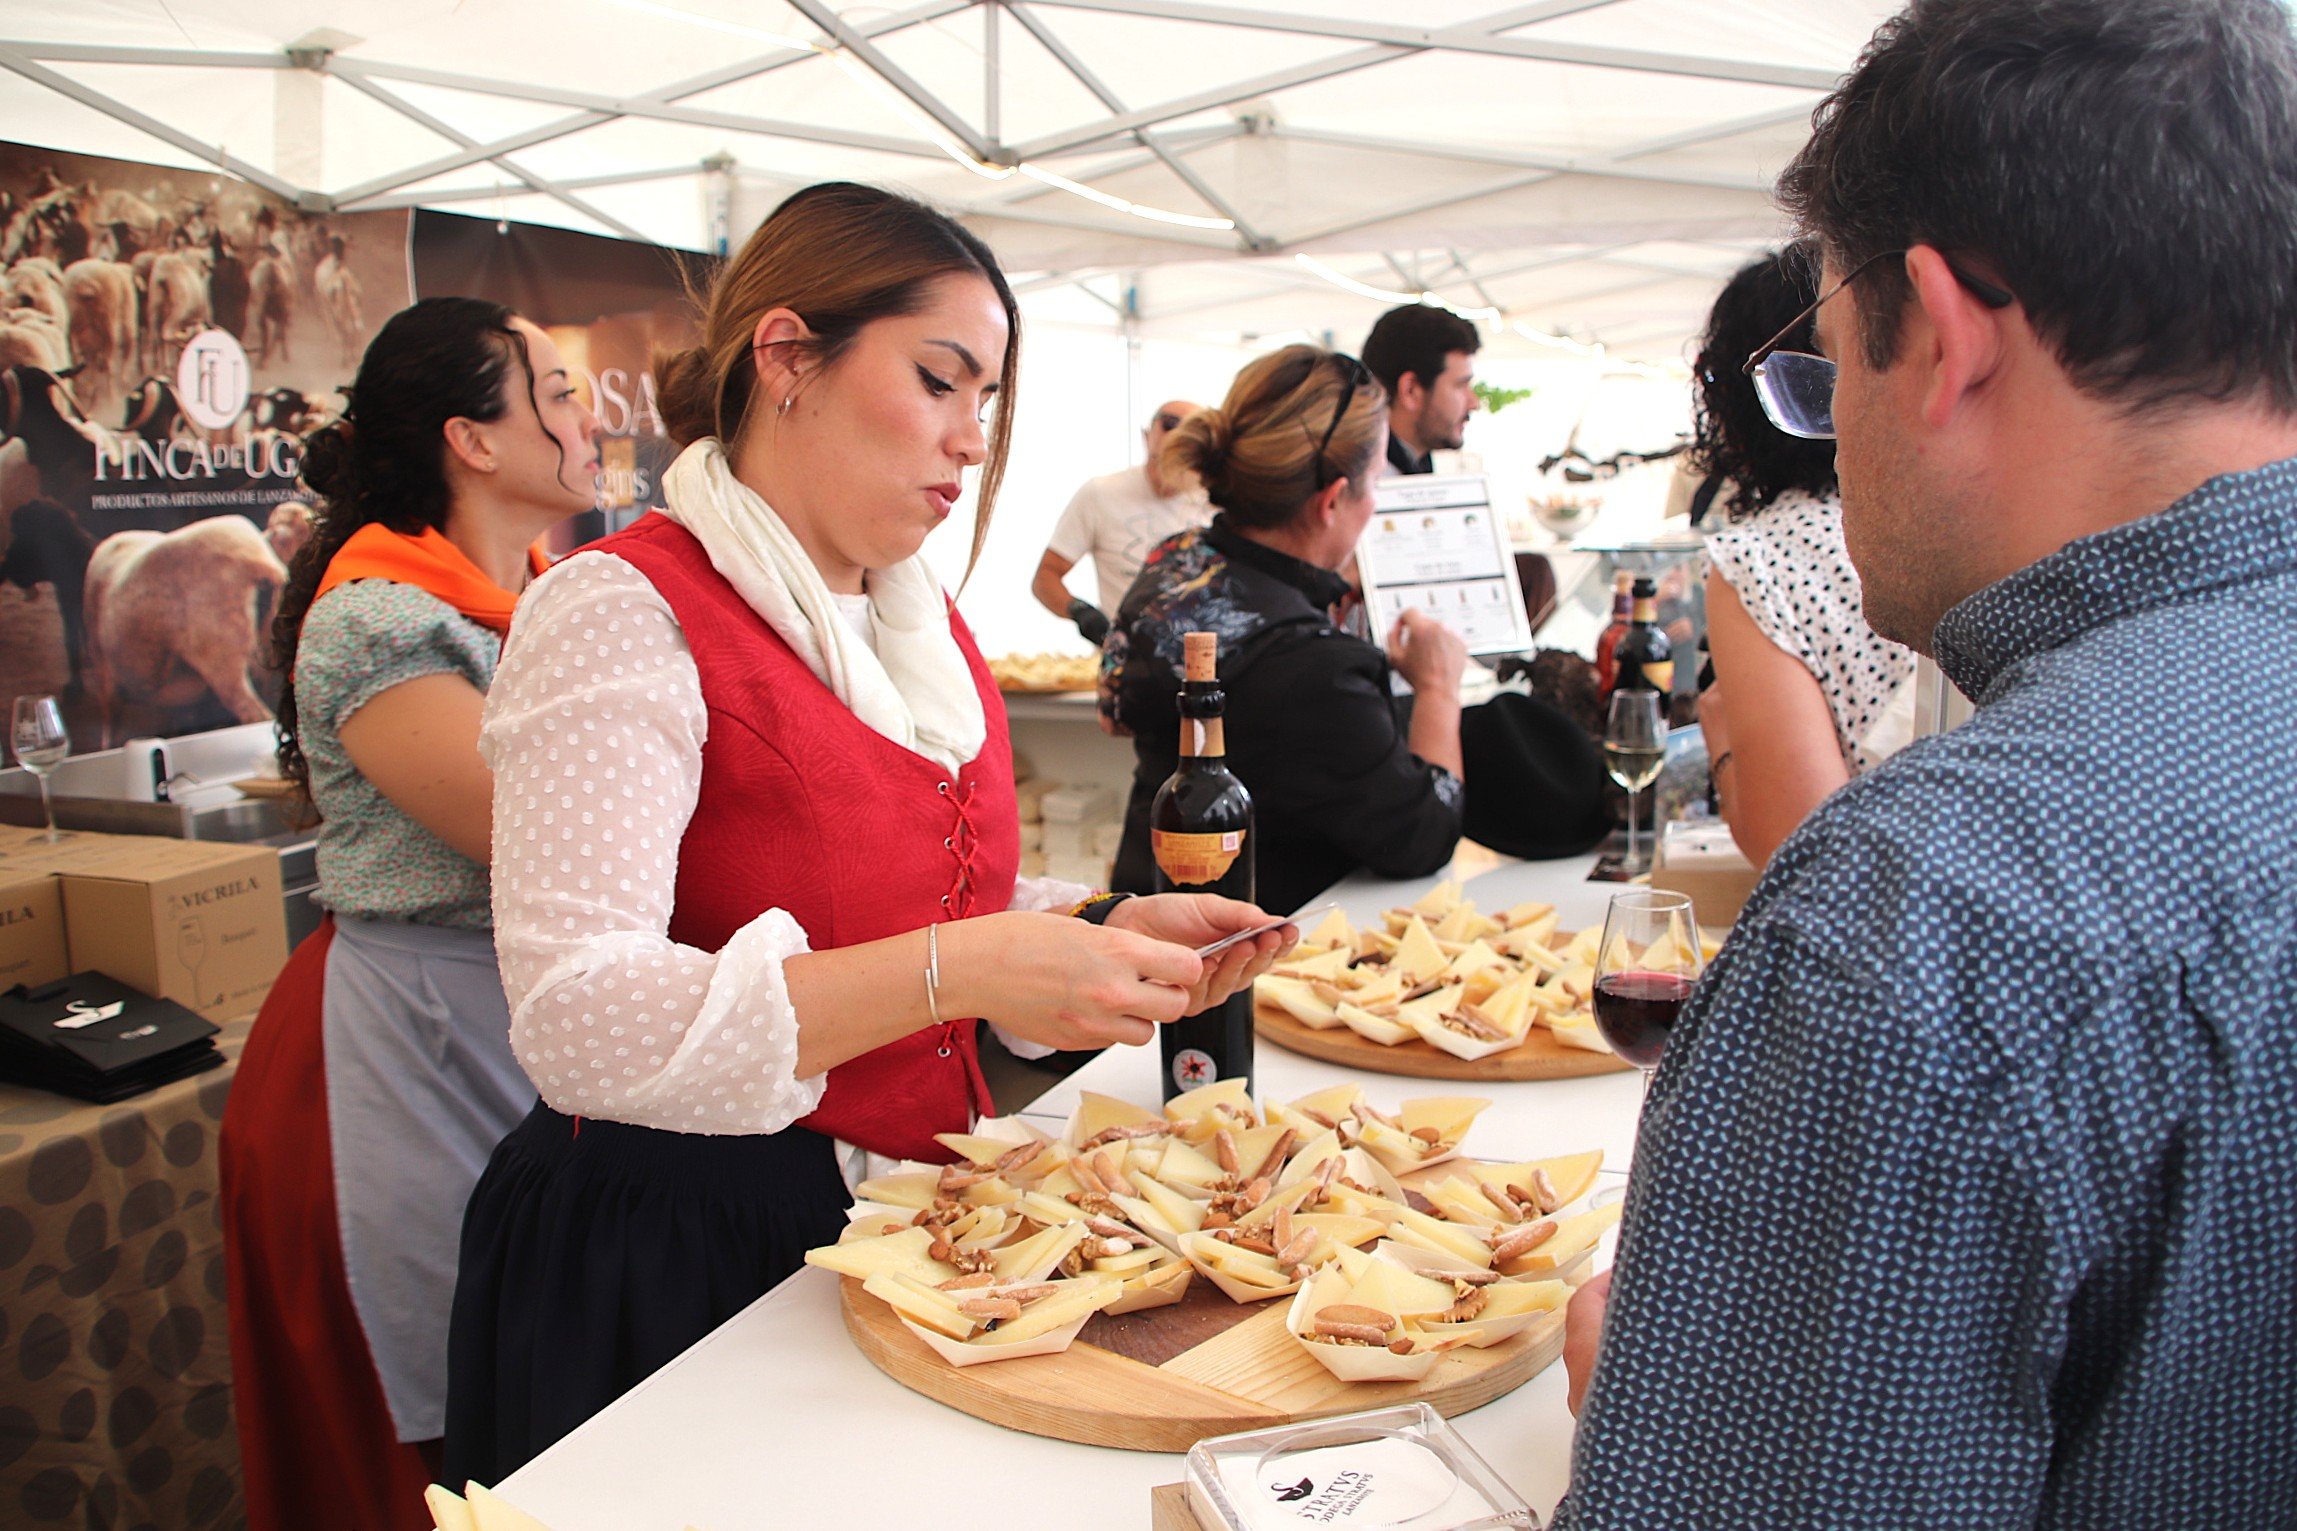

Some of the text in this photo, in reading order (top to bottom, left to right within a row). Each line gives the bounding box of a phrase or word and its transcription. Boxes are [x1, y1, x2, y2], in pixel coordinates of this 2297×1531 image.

[92, 433, 299, 481] FINCA DE UG
[92, 493, 167, 510] PRODUCTOS
[168, 491, 239, 507] ARTESANOS
[1319, 1500, 1347, 1523] ODEGA
